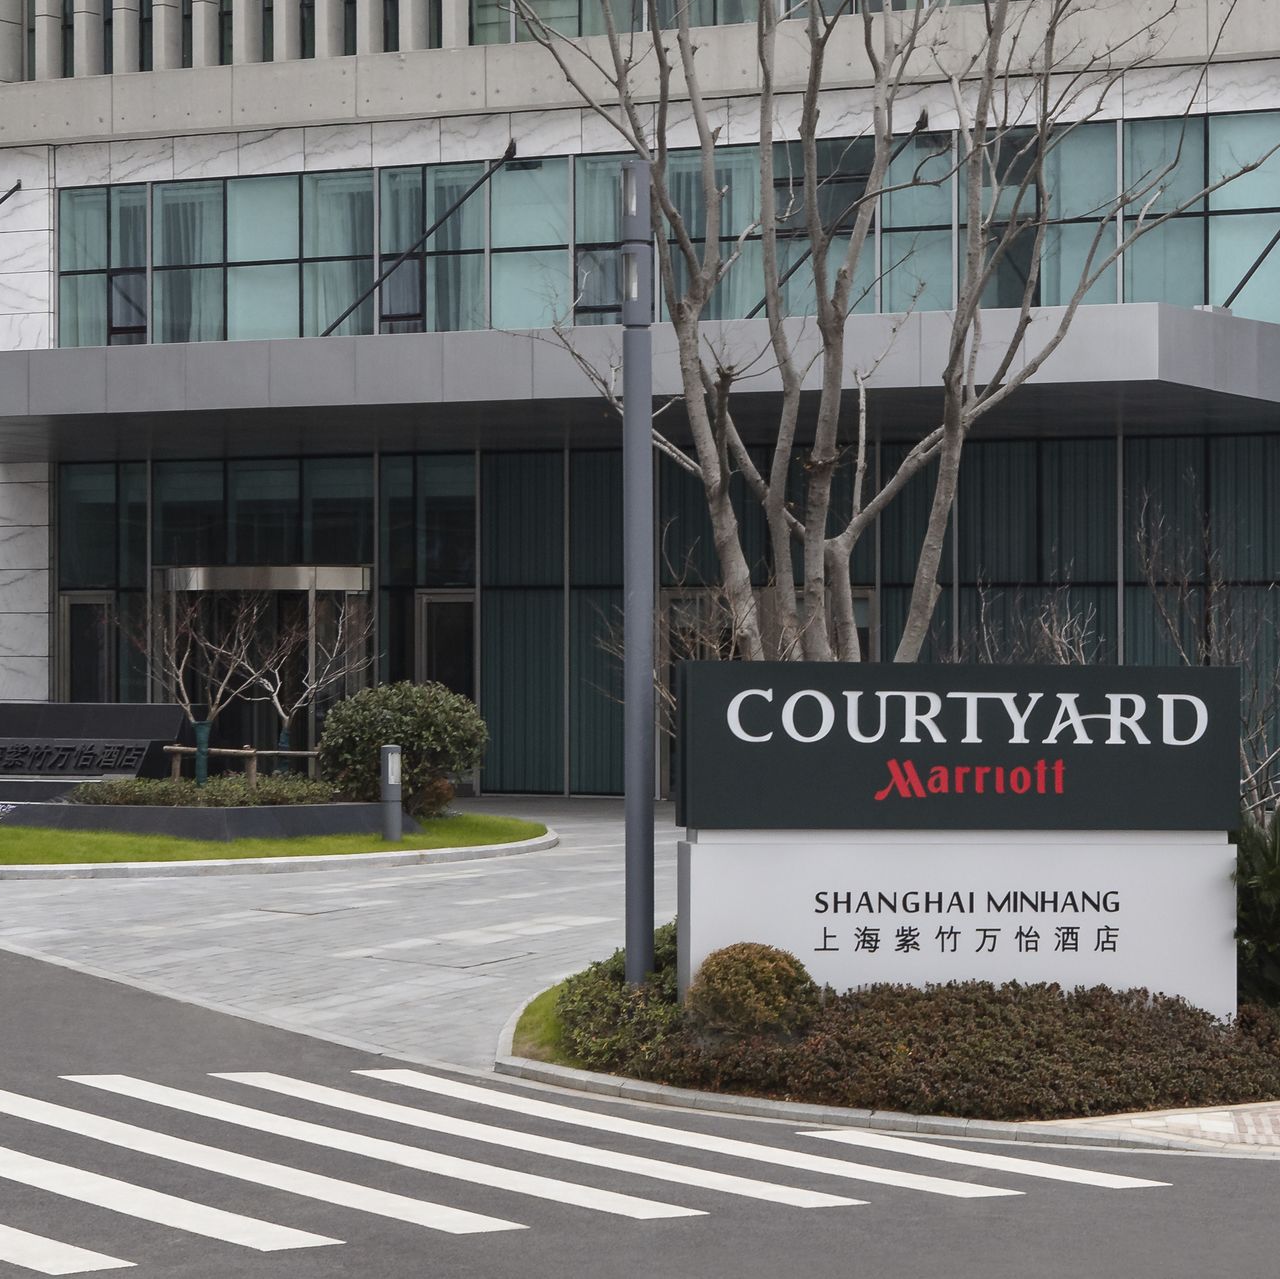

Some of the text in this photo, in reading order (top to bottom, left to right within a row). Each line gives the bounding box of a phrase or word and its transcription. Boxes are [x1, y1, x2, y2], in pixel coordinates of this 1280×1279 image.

[726, 688, 1209, 746] COURTYARD
[874, 759, 1065, 801] Marriott
[814, 890, 1120, 914] SHANGHAI MINHANG
[813, 924, 1120, 954] 上海紫竹万怡酒店
